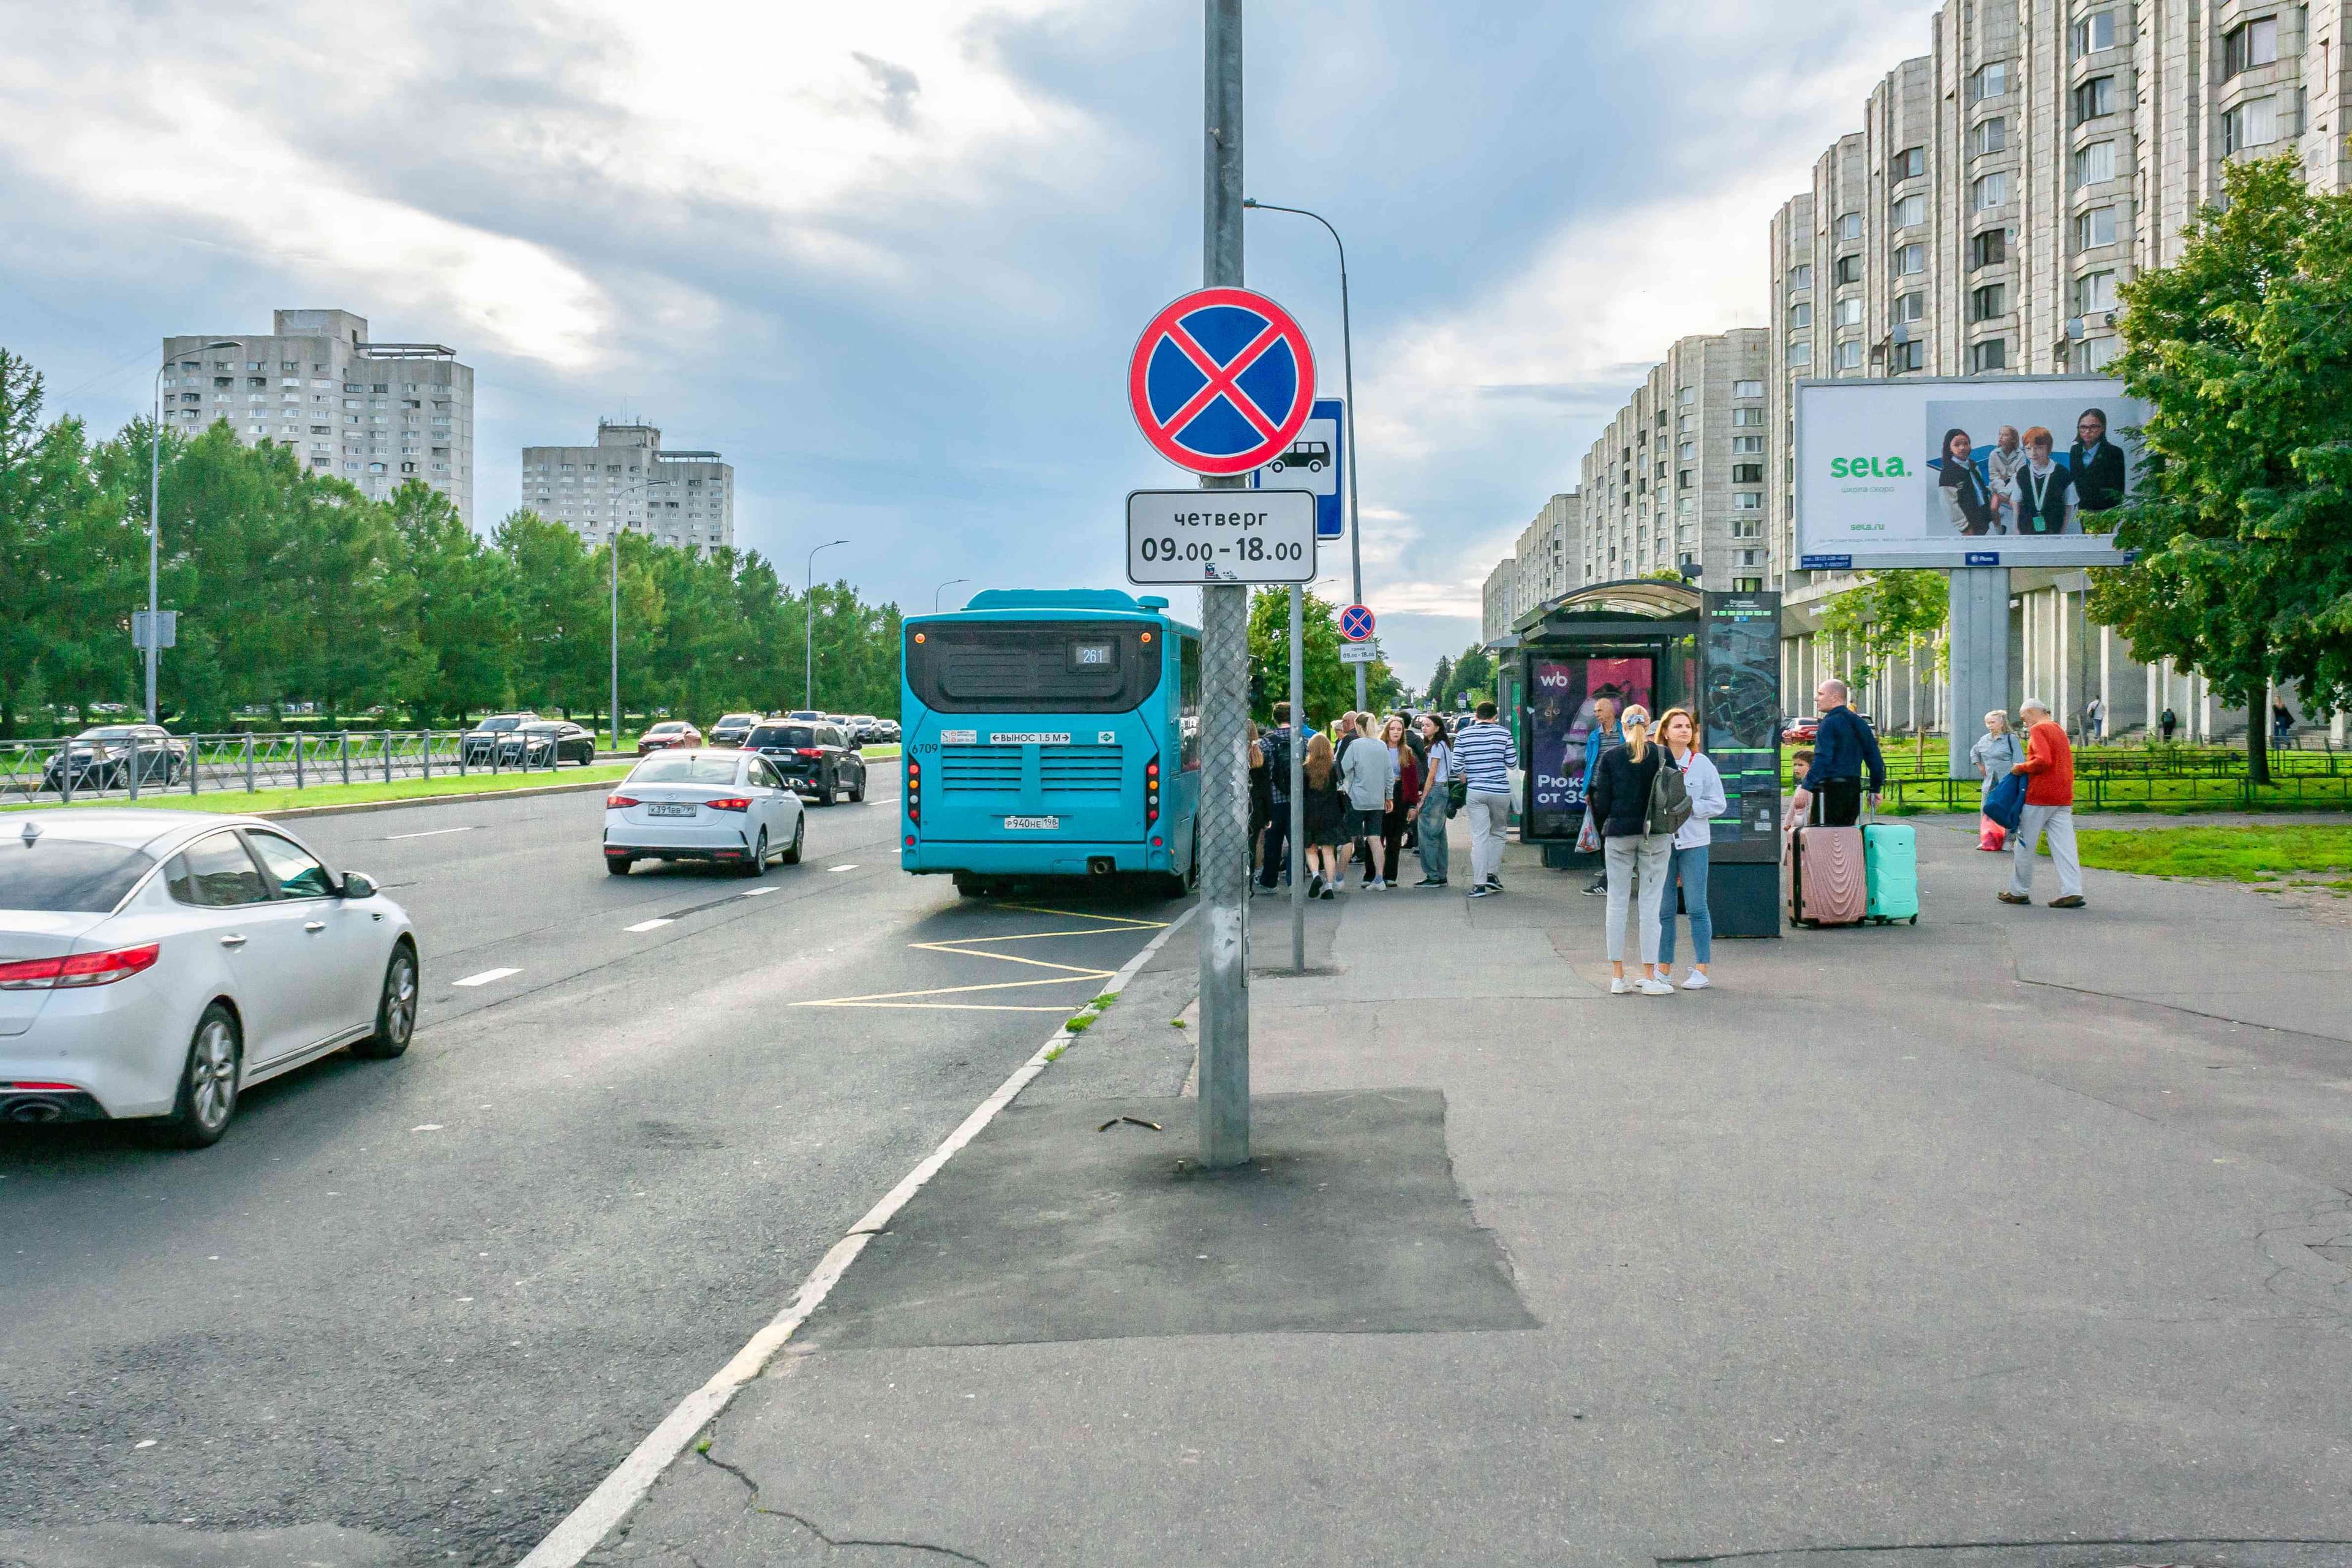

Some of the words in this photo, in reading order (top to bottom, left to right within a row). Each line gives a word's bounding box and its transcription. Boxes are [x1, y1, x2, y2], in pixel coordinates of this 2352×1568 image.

[1830, 456, 1912, 478] sela.
[1174, 512, 1268, 530] четверг
[1084, 649, 1102, 663] 261
[1540, 671, 1568, 687] wb
[911, 743, 938, 754] 6709
[1538, 774, 1584, 788] Рюк
[1537, 793, 1561, 804] от
